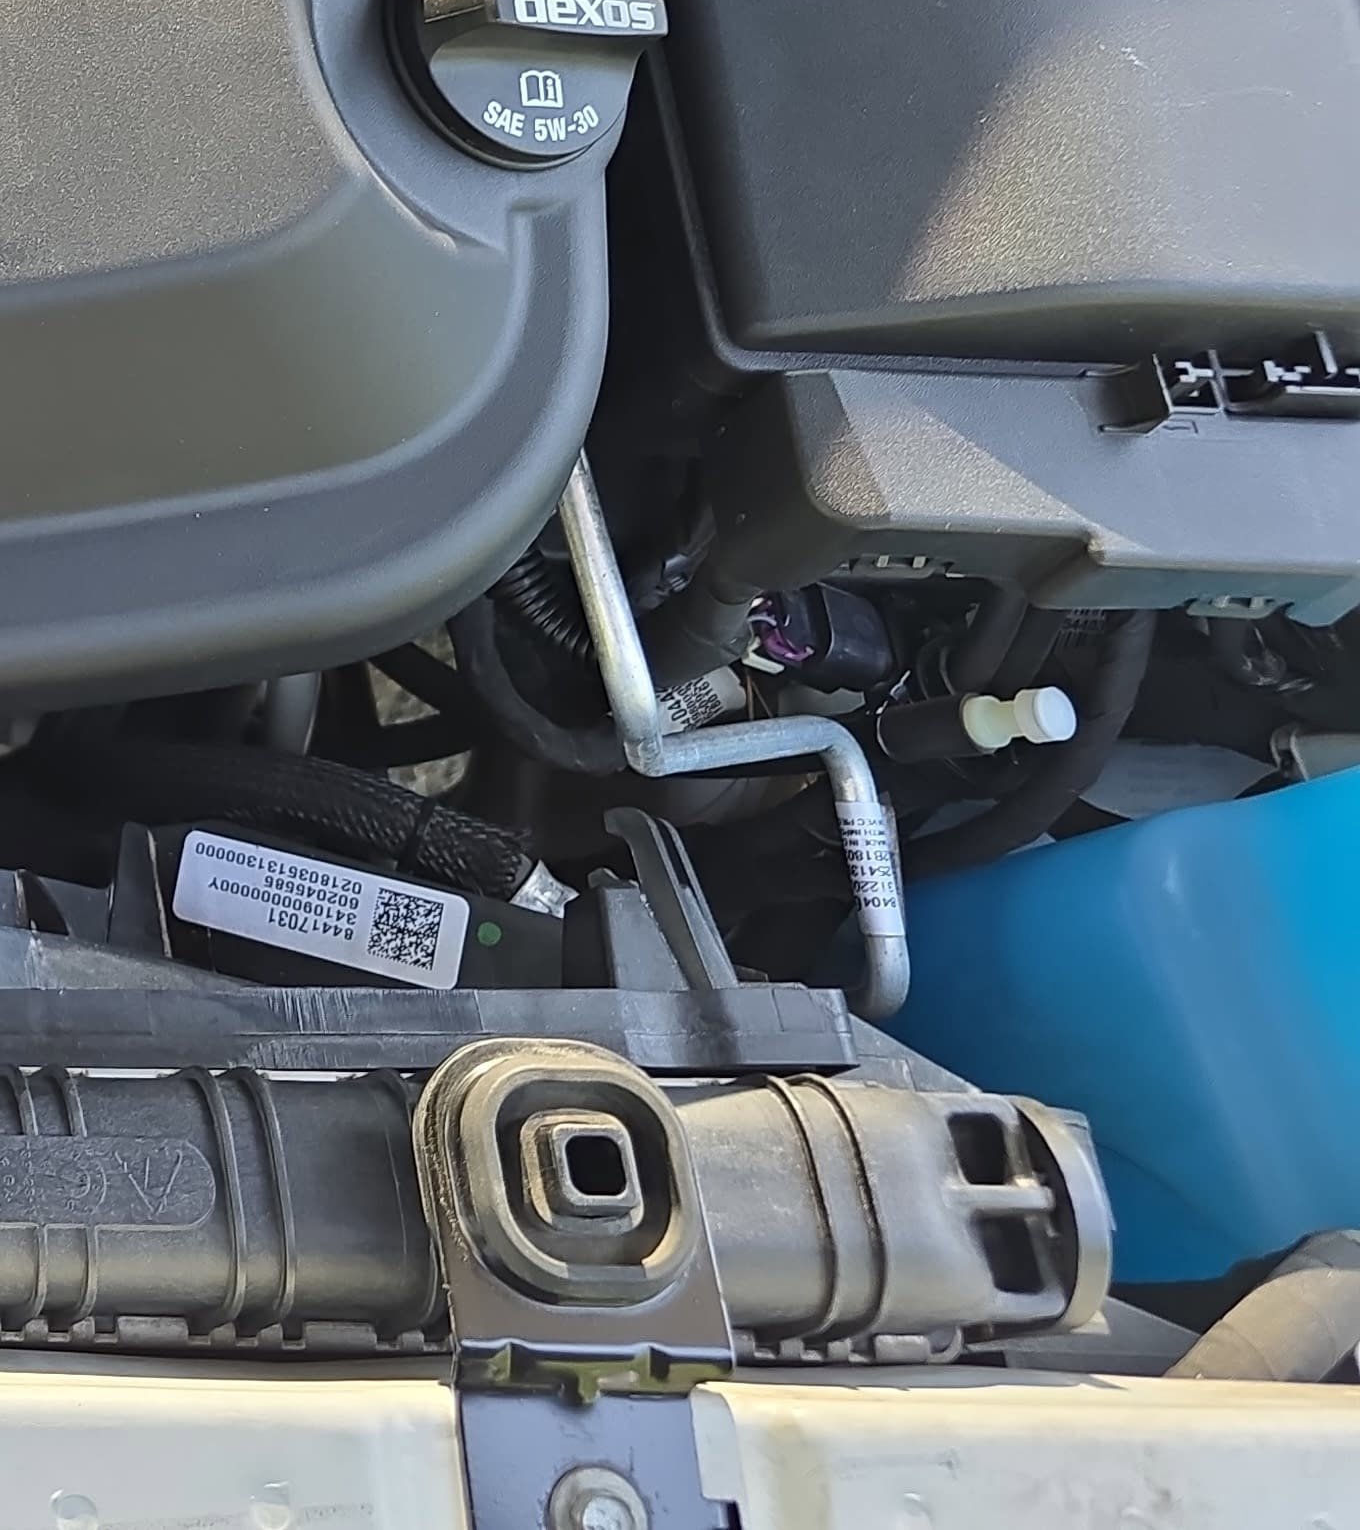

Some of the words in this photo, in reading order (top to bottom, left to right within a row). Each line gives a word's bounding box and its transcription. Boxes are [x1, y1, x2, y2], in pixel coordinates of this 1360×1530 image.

[482, 100, 526, 138] SAE
[533, 104, 599, 142] 5W-30
[267, 907, 355, 942] 84417031
